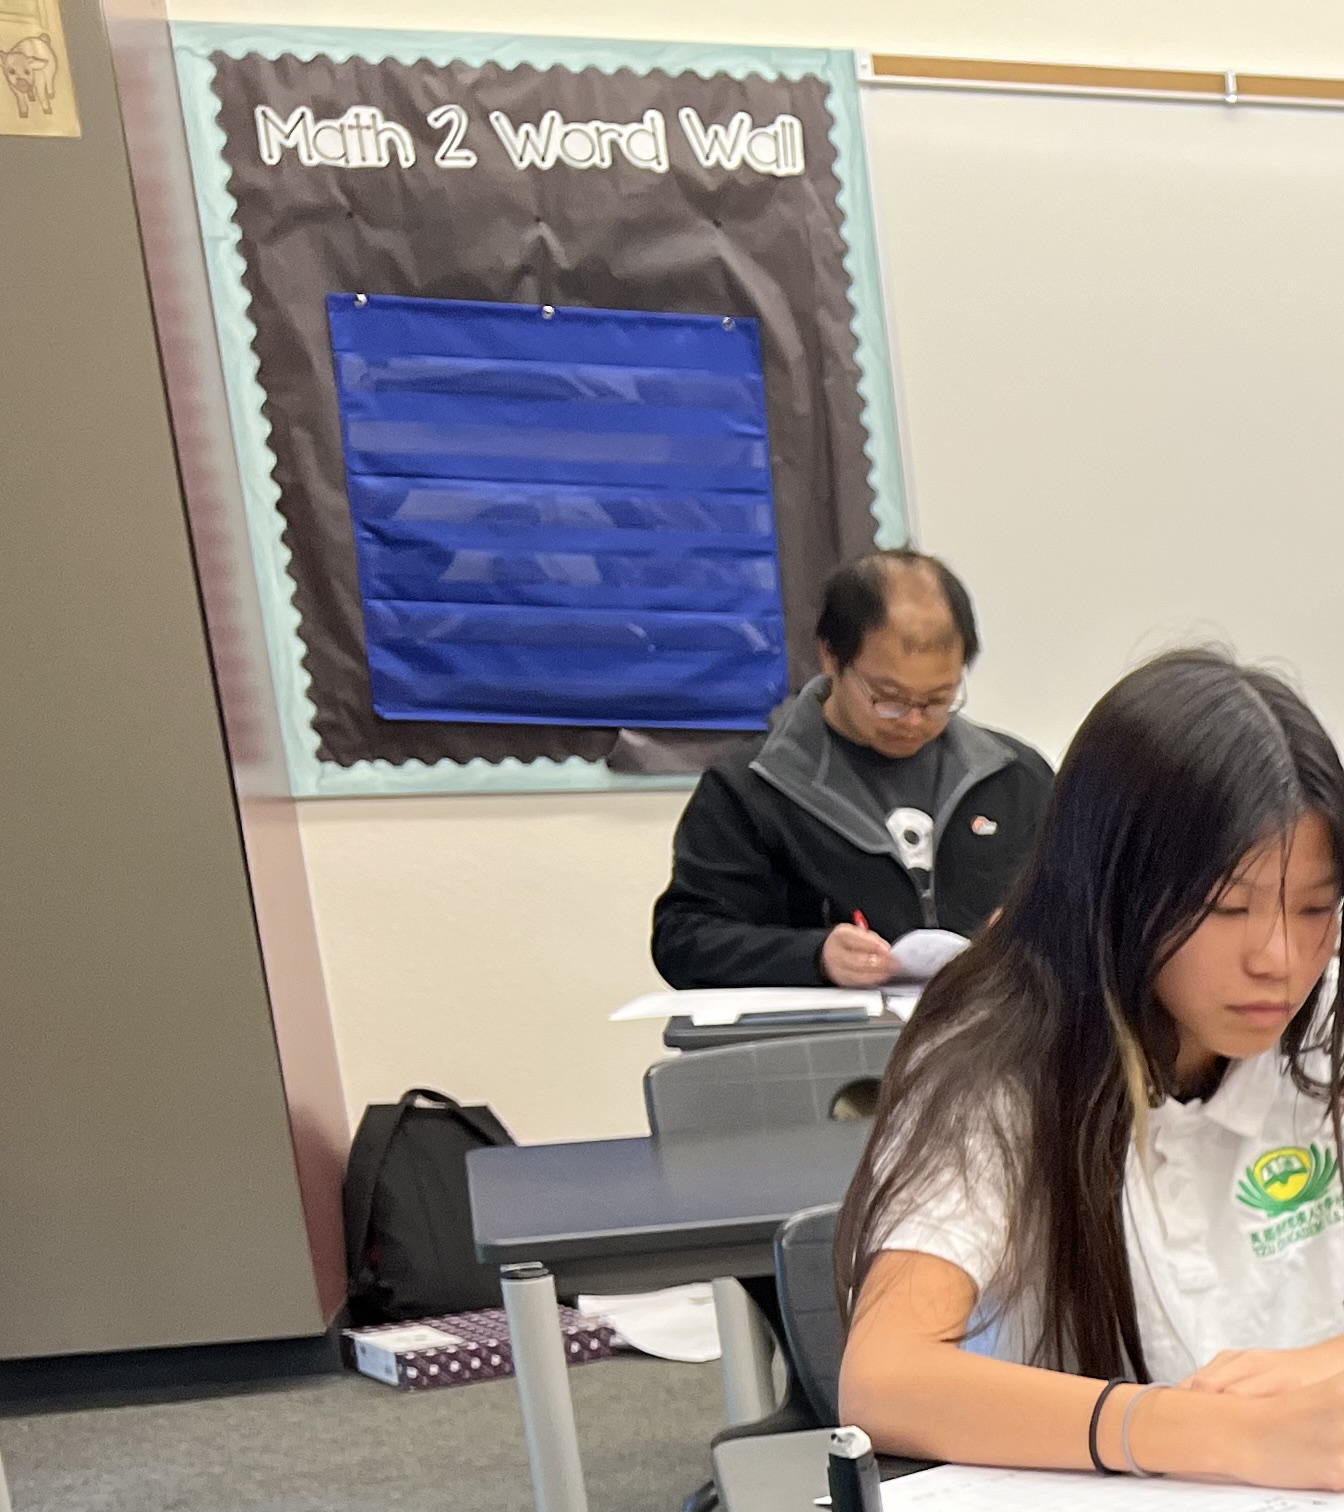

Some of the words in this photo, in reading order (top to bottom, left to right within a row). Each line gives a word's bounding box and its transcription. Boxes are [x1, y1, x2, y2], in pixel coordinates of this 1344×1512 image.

[255, 104, 417, 169] Math
[427, 102, 478, 170] 2
[489, 107, 670, 174] Word
[678, 106, 806, 177] Wall
